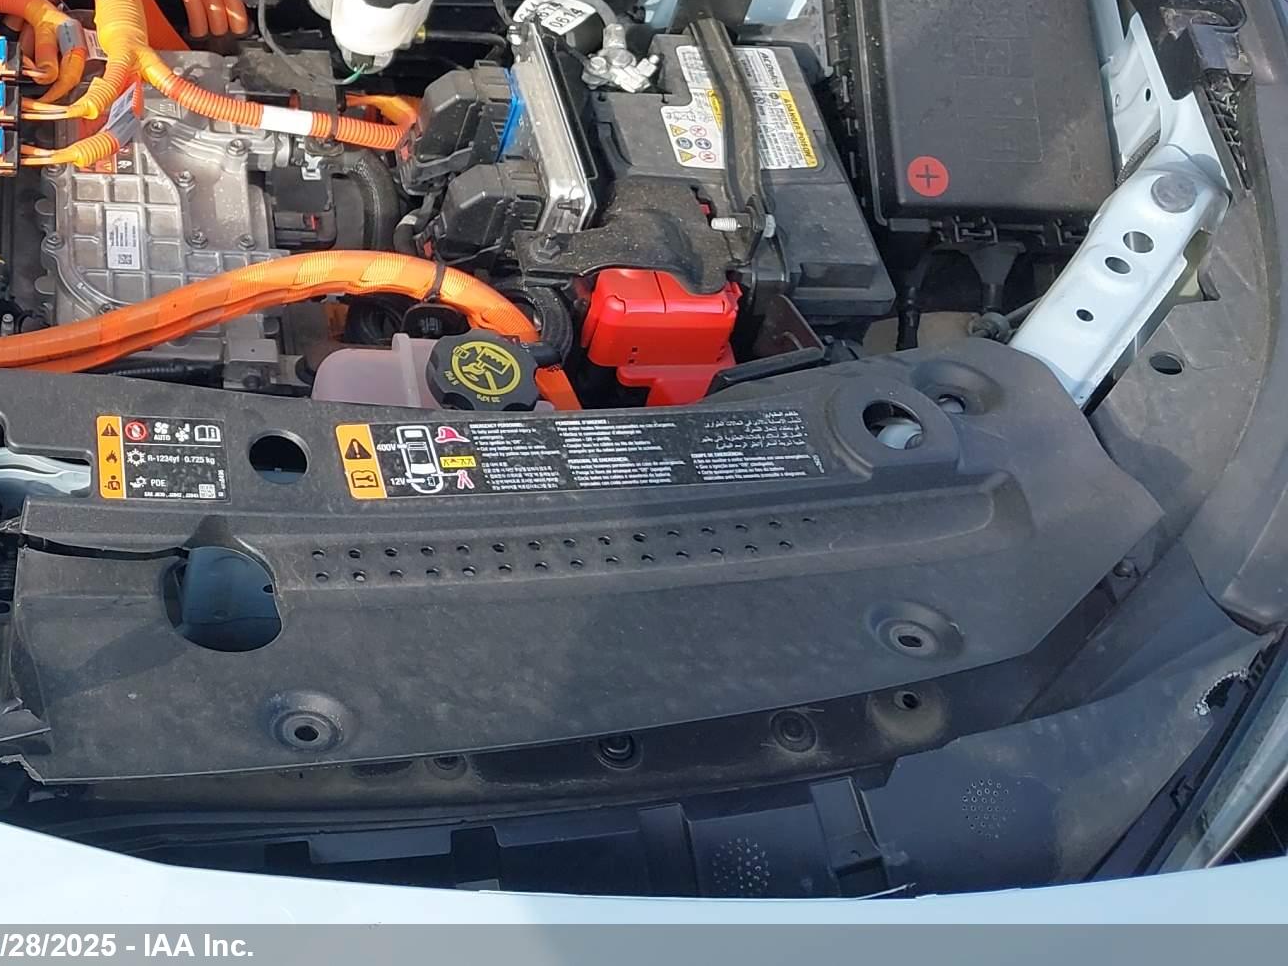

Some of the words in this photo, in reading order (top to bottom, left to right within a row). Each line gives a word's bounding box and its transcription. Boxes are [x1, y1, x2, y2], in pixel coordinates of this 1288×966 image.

[550, 8, 585, 28] 0614
[377, 443, 396, 452] 400V
[148, 455, 179, 464] R-1234yf
[206, 457, 215, 465] kg
